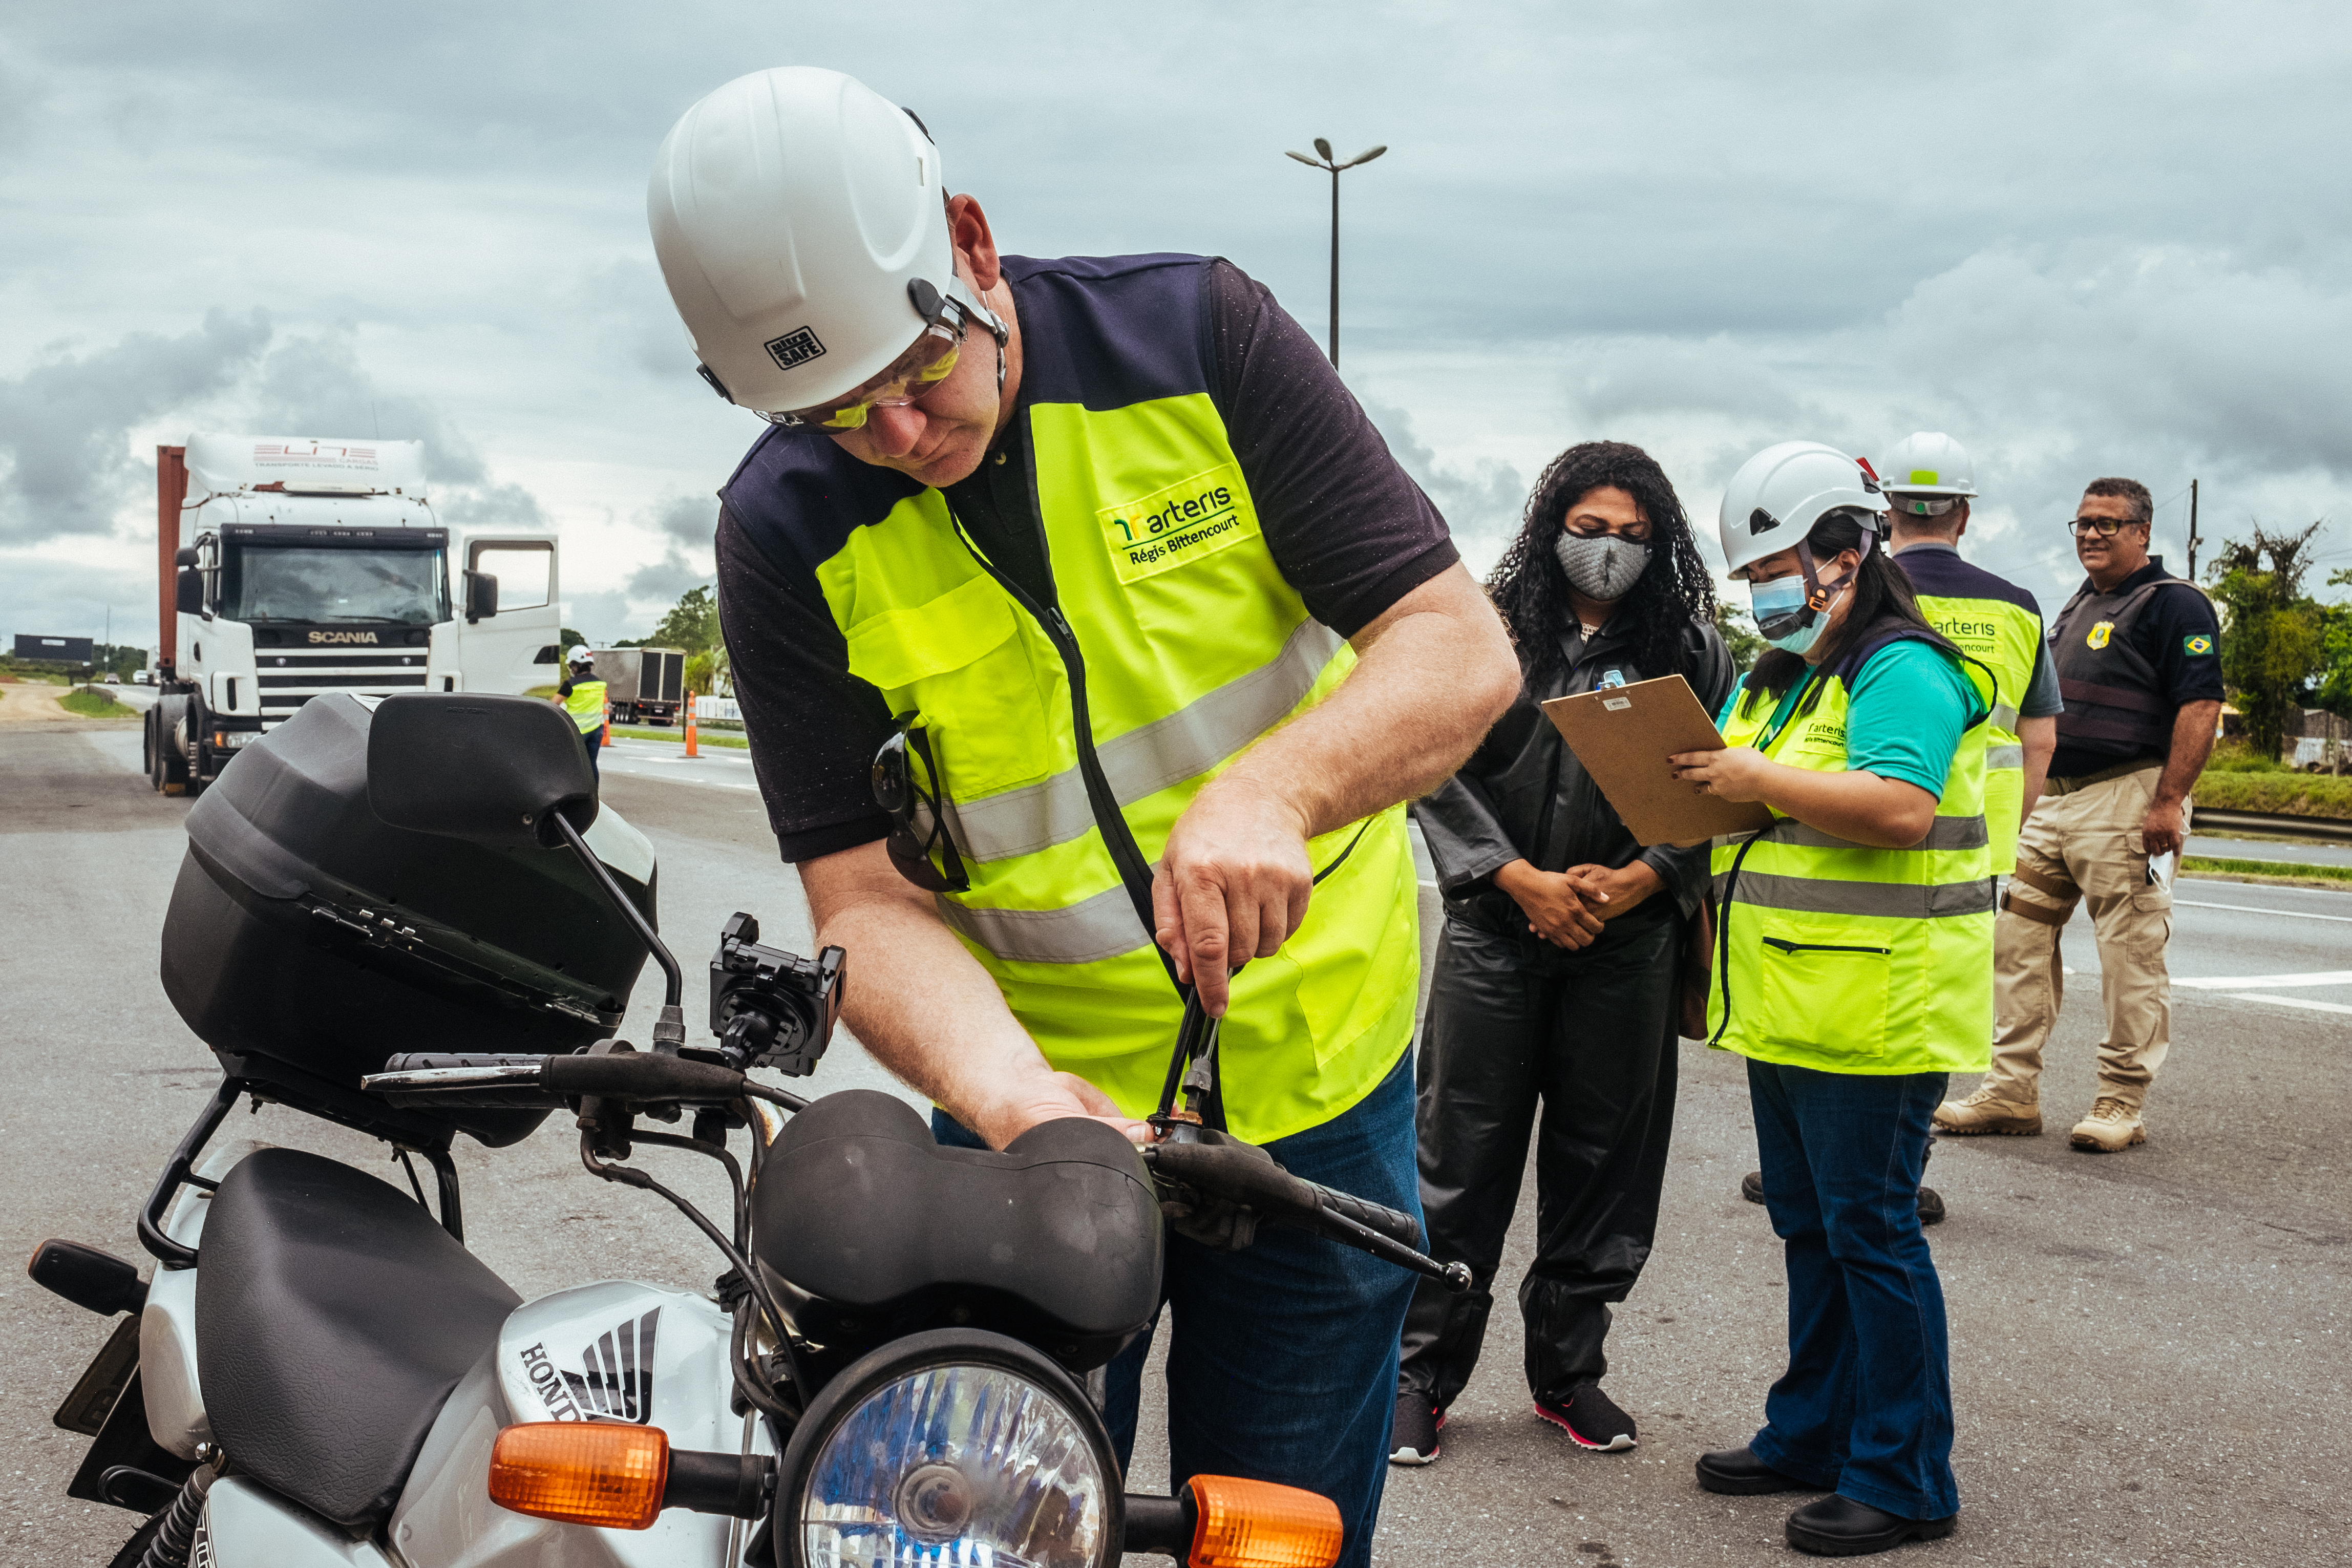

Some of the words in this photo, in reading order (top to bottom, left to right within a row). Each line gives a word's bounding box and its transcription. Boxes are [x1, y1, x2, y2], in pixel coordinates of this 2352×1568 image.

[770, 331, 810, 351] ultra
[778, 341, 821, 366] SAFE
[1146, 487, 1231, 534] arteris
[1129, 544, 1166, 565] Régis
[1166, 514, 1240, 553] Bittencourt
[1933, 617, 1995, 635] arteris
[308, 631, 378, 644] SCANIA
[1813, 723, 1846, 738] arteris
[520, 1342, 582, 1422] HOND
